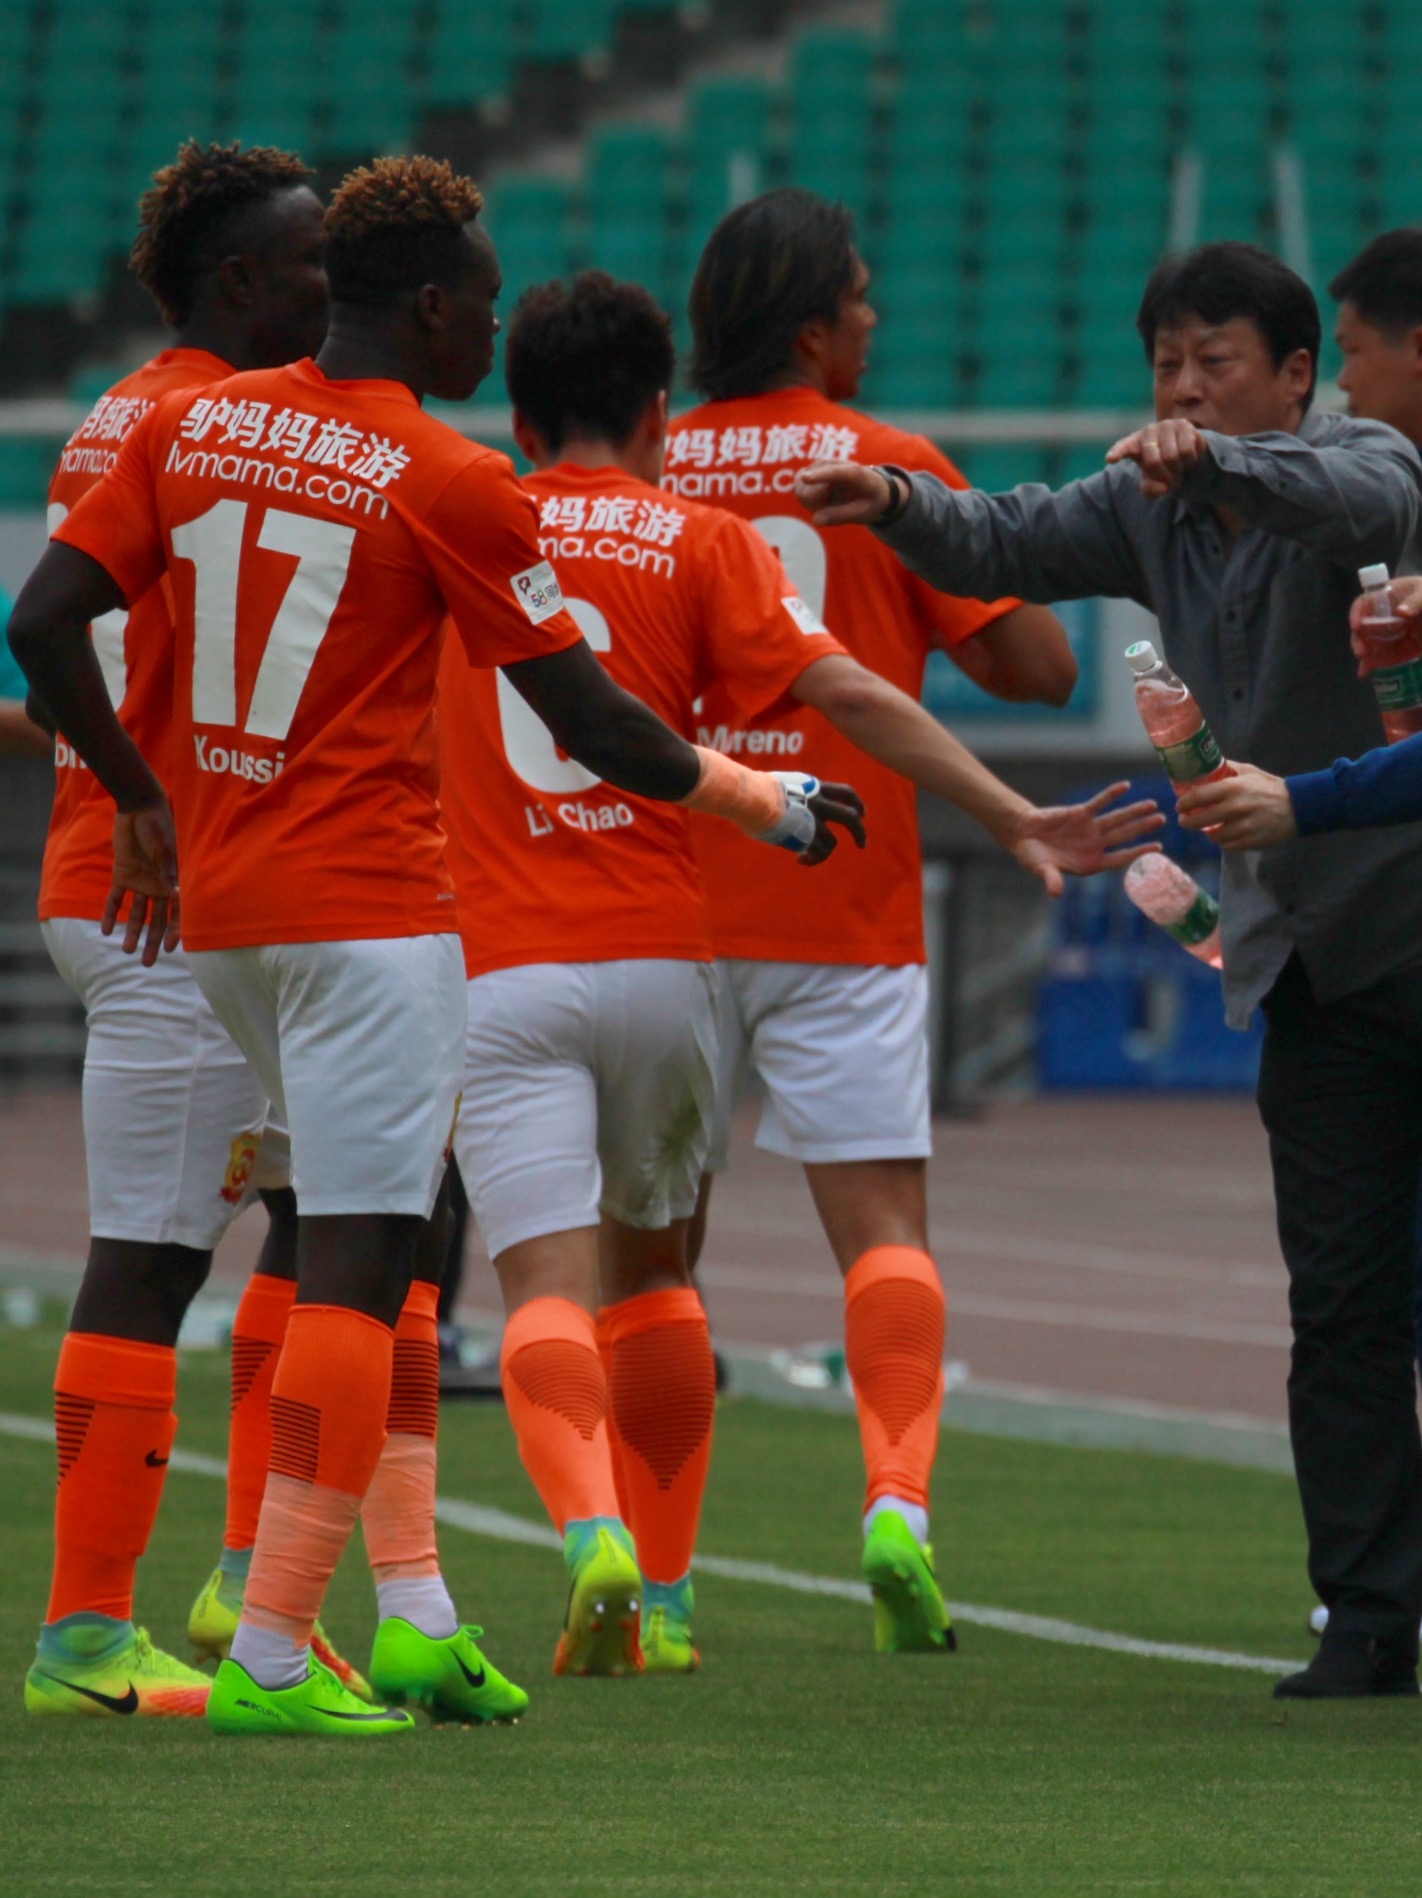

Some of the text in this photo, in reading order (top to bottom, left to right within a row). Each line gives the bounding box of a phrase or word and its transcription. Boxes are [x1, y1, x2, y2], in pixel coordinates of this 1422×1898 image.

[180, 397, 412, 489] 驴妈妈旅游
[665, 423, 859, 467] 妈妈旅游
[165, 440, 391, 520] lvmama.com
[530, 495, 686, 547] 妈旅游
[171, 498, 357, 741] 17
[696, 725, 804, 755] Mreno
[524, 802, 635, 837] Li Chao
